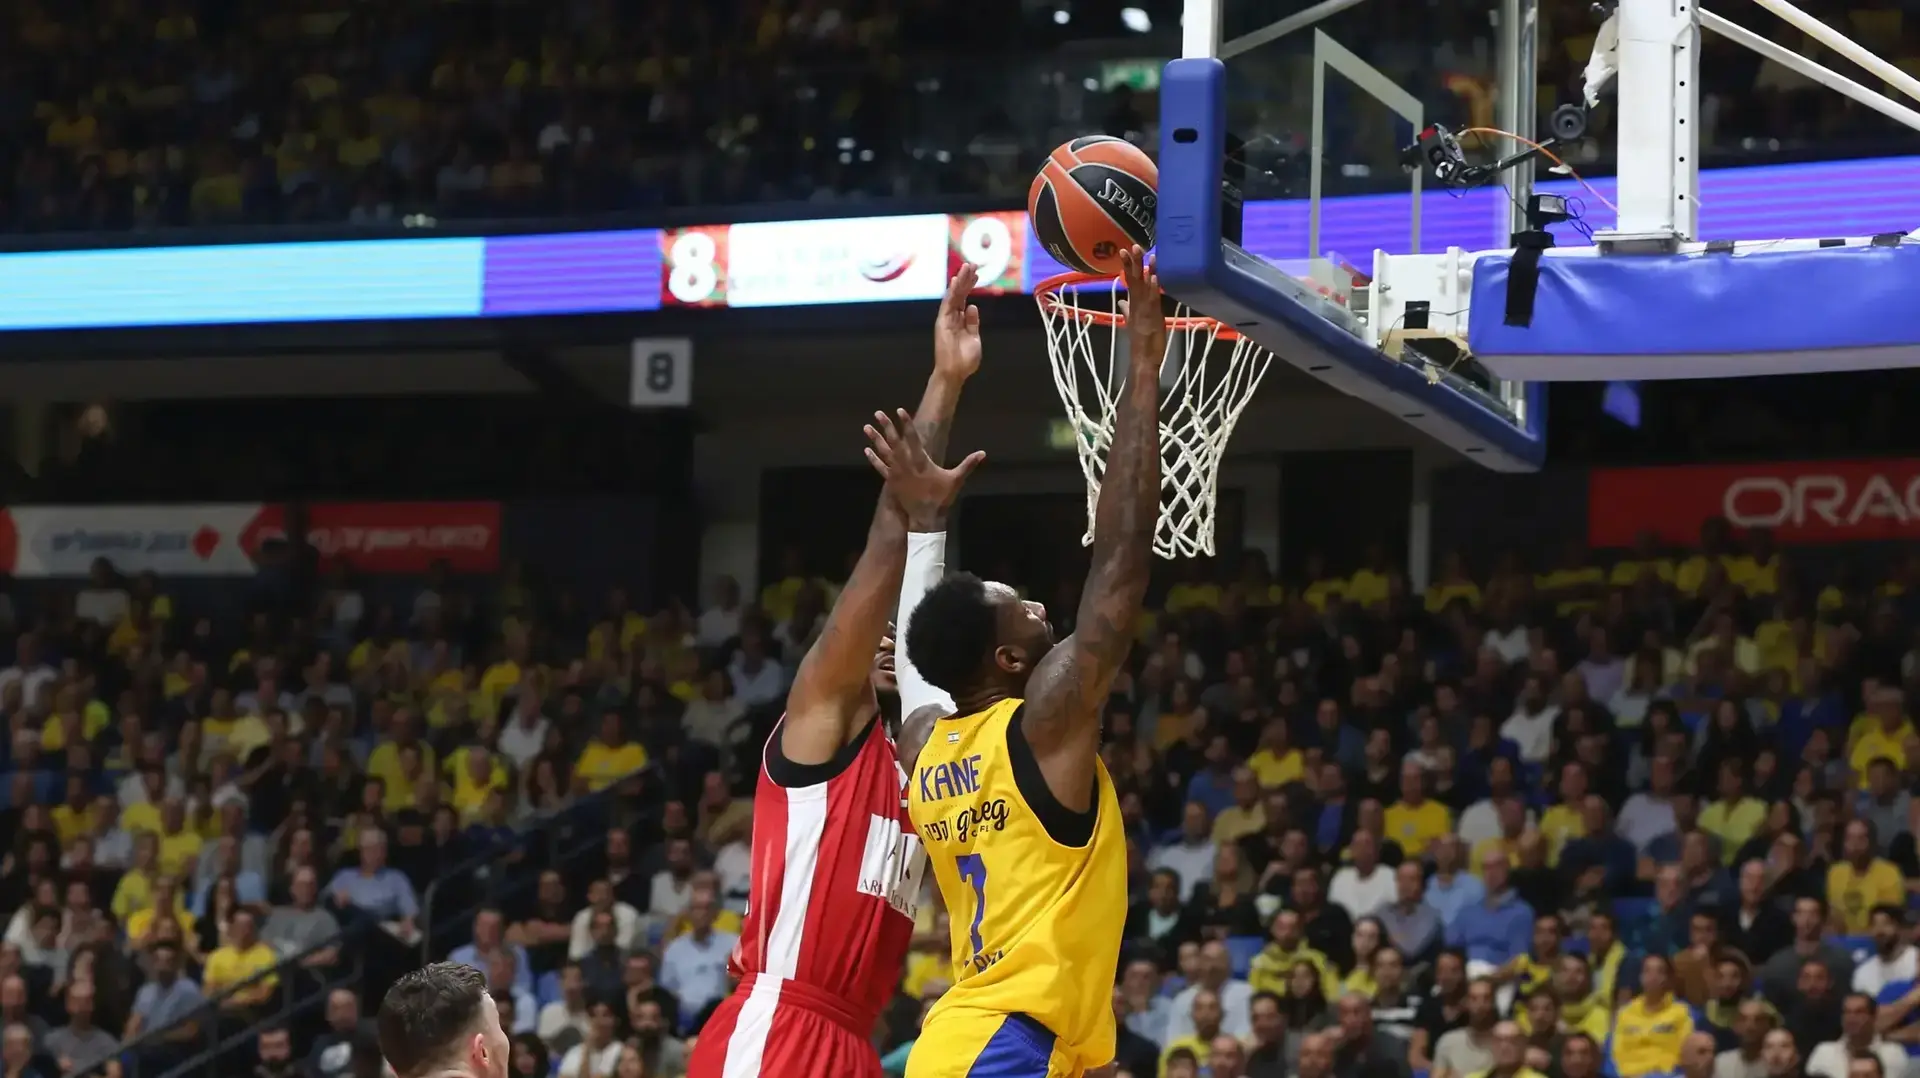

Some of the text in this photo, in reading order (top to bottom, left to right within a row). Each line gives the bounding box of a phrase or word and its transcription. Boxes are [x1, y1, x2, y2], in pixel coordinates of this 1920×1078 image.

[669, 231, 717, 303] 8
[961, 216, 1011, 288] 9
[646, 352, 674, 393] 8
[1723, 474, 1920, 527] ORA
[920, 754, 982, 802] KANE
[957, 799, 1010, 843] greg
[955, 853, 986, 954] 7
